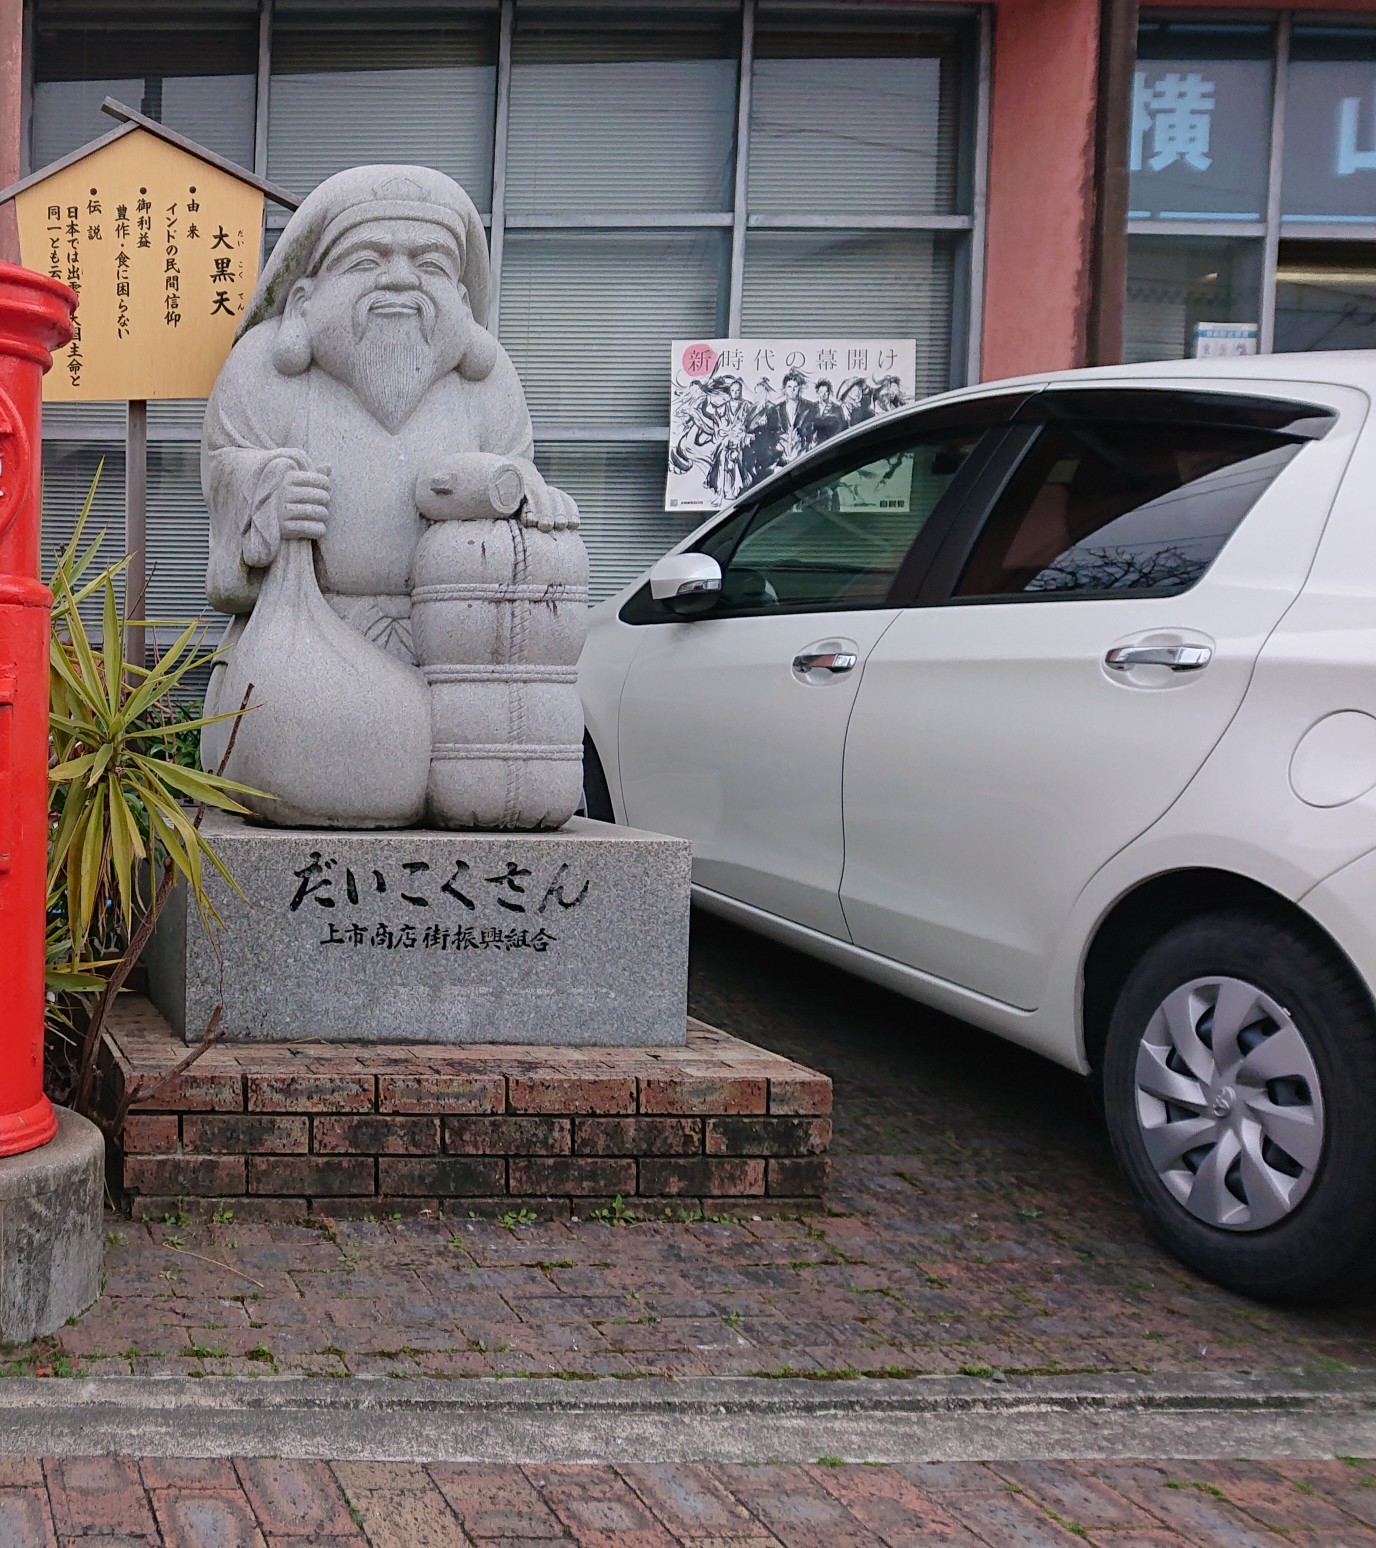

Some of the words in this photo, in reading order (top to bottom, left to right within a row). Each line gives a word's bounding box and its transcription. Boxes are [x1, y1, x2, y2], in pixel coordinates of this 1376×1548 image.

[87, 200, 102, 240] 伝説
[135, 198, 152, 248] 御利益
[186, 198, 200, 239] 由来
[114, 204, 131, 339] 豊作・食に困らない
[164, 202, 181, 328] インドの民間信仰
[209, 225, 236, 316] 大黒天
[688, 348, 898, 372] 新時代の幕開け
[289, 851, 590, 913] だいこくさん
[320, 922, 558, 952] 上市商店街振興組合
